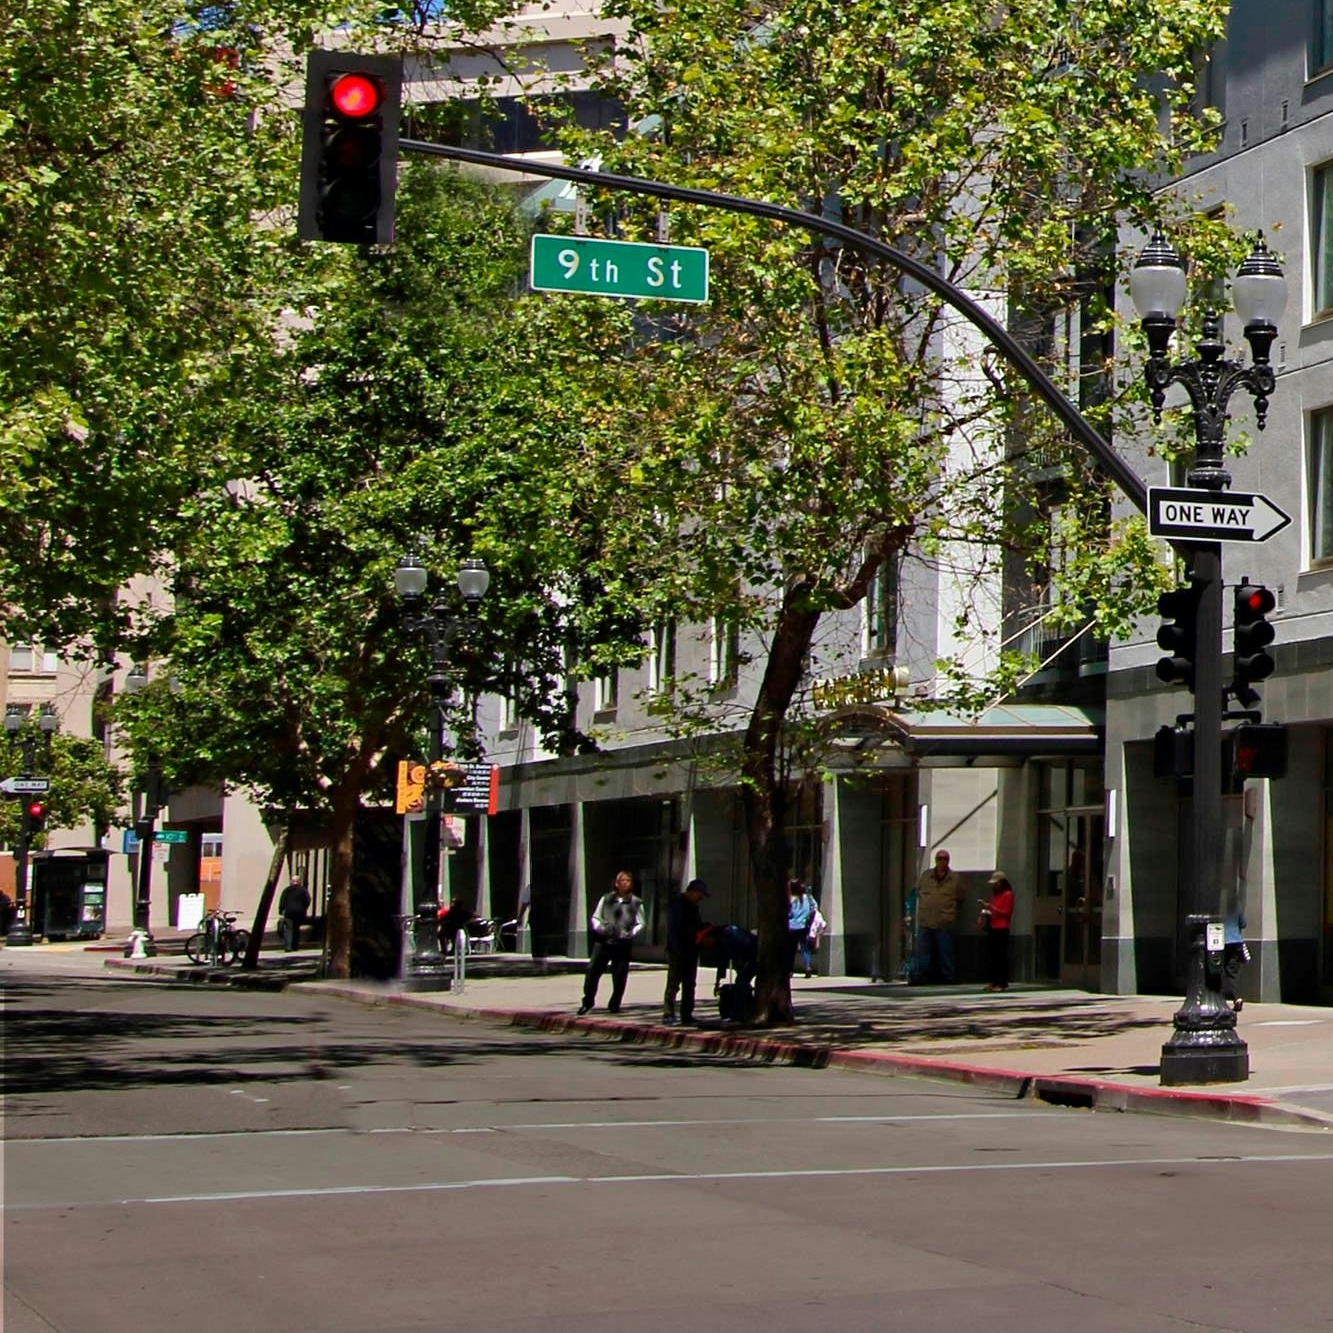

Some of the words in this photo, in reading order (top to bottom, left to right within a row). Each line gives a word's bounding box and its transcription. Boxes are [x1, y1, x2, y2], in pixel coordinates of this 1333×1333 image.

[558, 249, 618, 283] 9th
[646, 257, 682, 288] St
[1166, 504, 1203, 523] ONE
[1211, 507, 1250, 525] WAY
